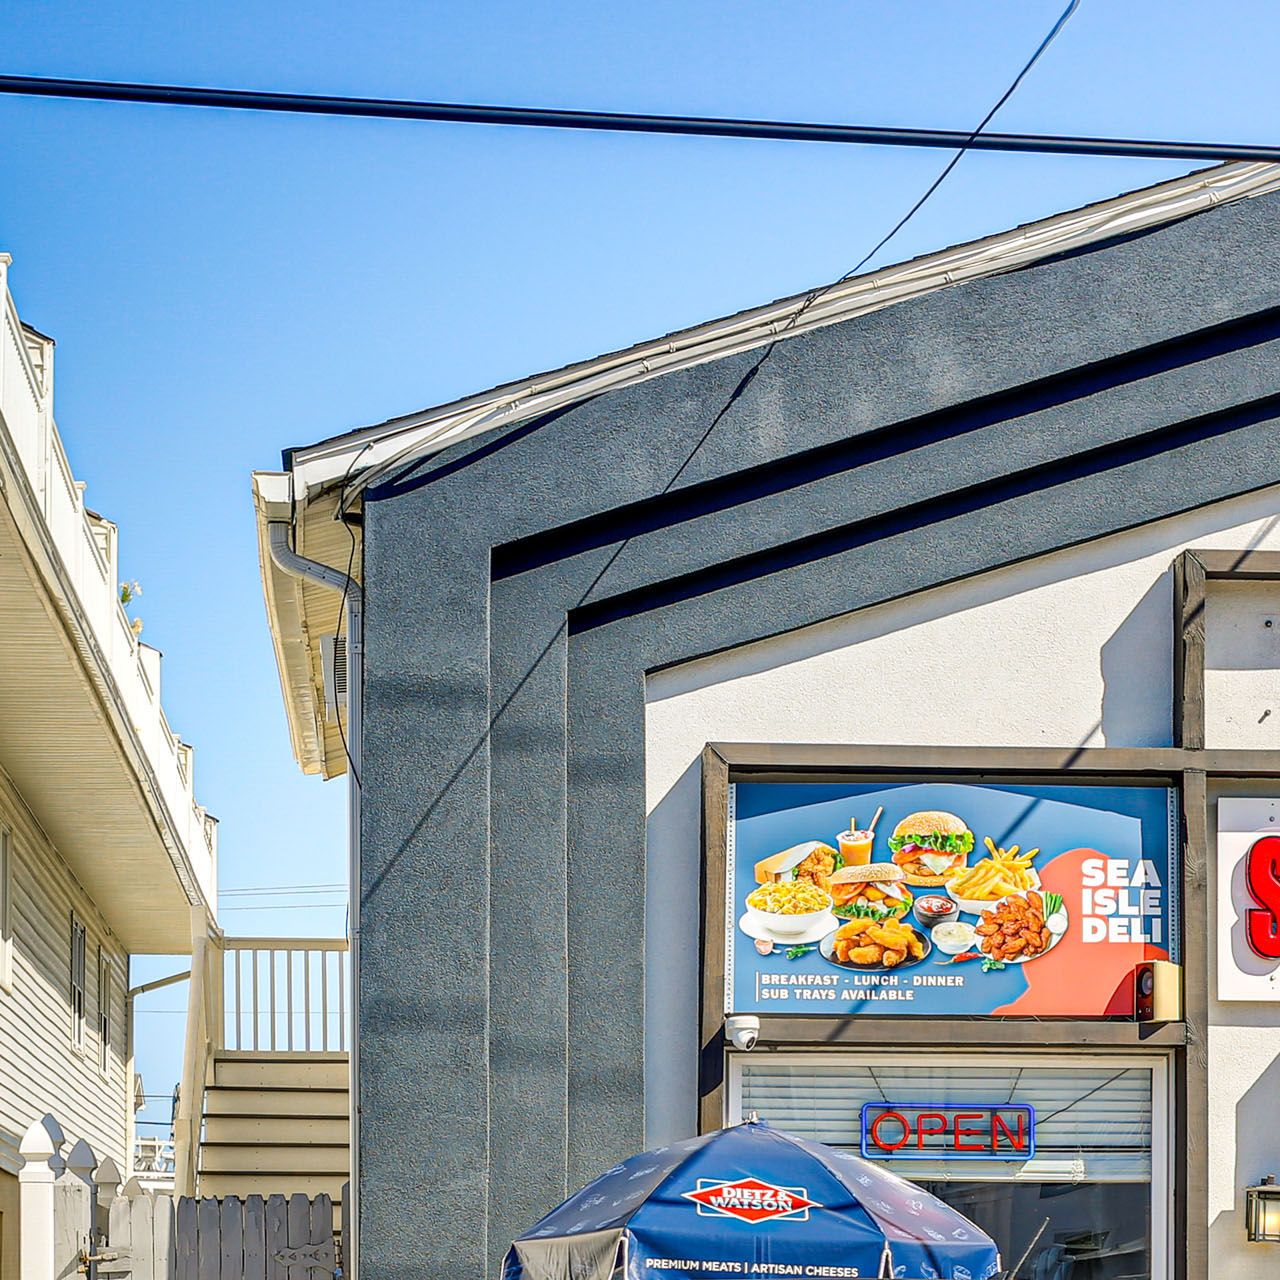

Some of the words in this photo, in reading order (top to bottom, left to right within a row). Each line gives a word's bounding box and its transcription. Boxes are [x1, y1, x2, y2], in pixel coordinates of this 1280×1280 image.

[1081, 858, 1162, 887] SEA
[1082, 888, 1162, 916] ISLE
[1082, 917, 1162, 943] DELI
[761, 974, 839, 986] BREAKFAST
[854, 975, 899, 986] LUNCH
[913, 976, 964, 987] DINNER
[761, 988, 789, 999] SUB
[794, 989, 836, 1000] TRAYS
[841, 989, 914, 1001] AVAILABLE
[870, 1111, 1025, 1153] OPEN
[709, 1196, 793, 1211] WATSON
[722, 1187, 776, 1201] DIETZ
[776, 1191, 789, 1201] &
[646, 1258, 699, 1271] PREMIUM
[702, 1261, 742, 1272] MEATS
[751, 1264, 803, 1275] ARTISAN
[805, 1266, 859, 1278] CHEESES
